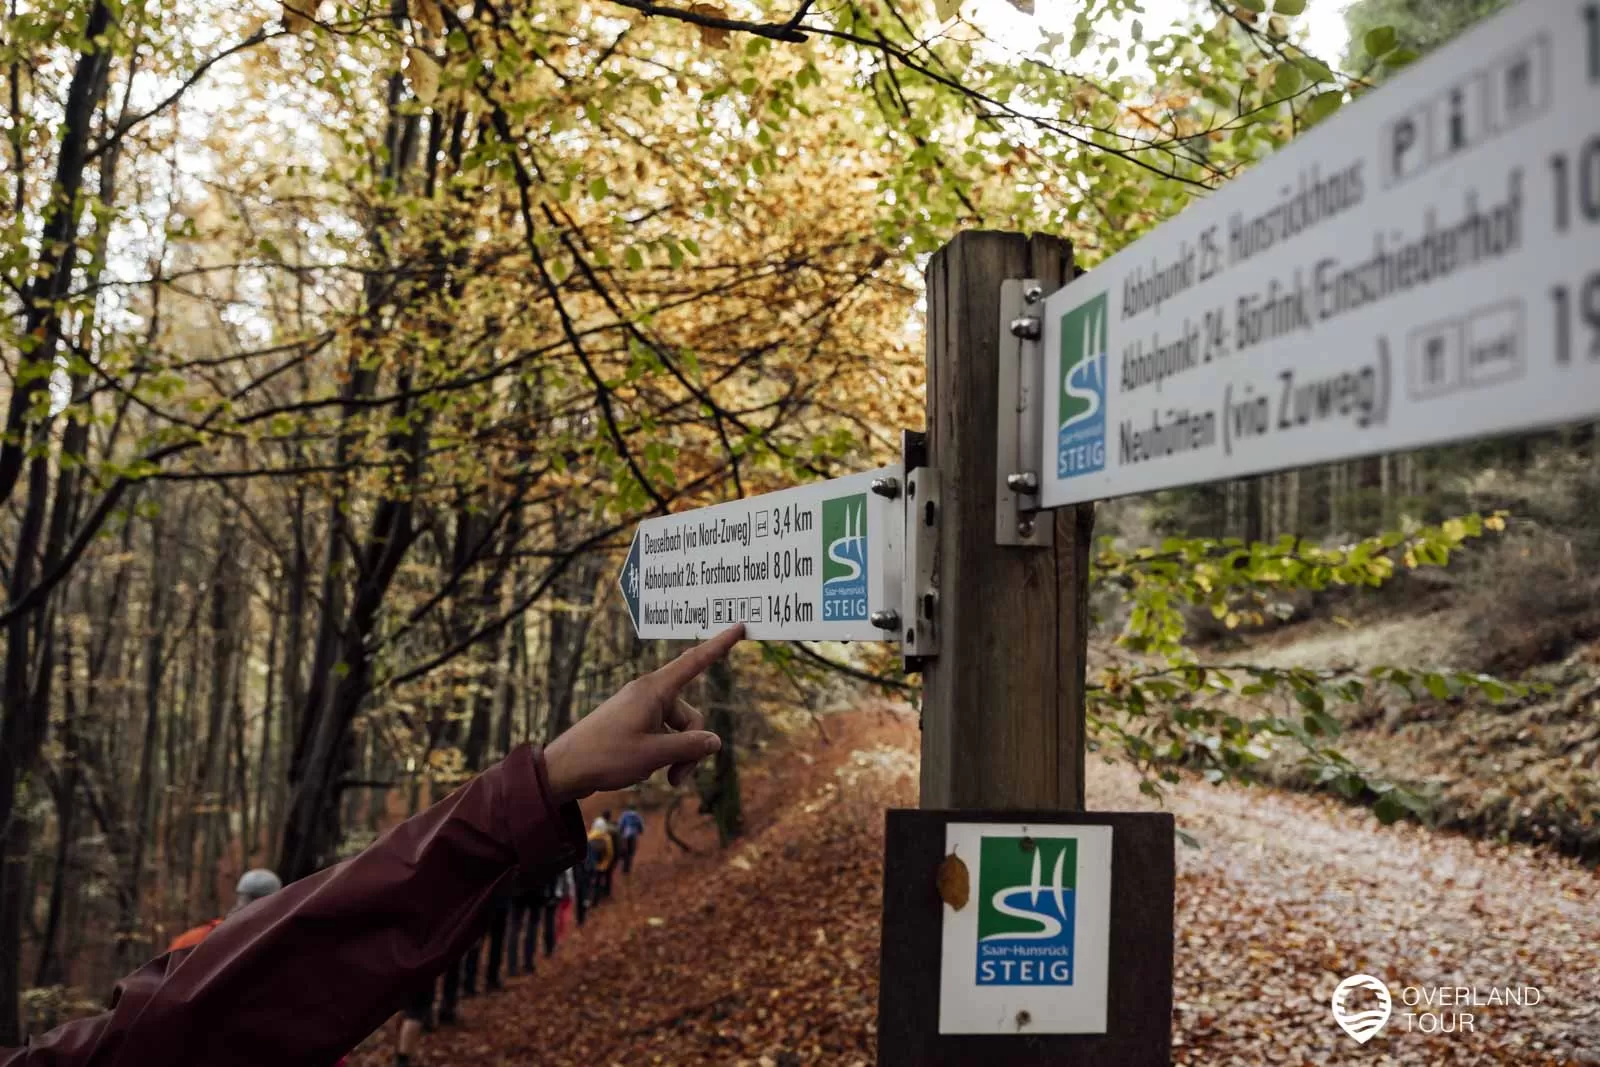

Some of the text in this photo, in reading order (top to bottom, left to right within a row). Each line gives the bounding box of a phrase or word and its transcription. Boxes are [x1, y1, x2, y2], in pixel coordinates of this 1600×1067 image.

[1120, 239, 1195, 321] Abholpunkt
[1120, 317, 1198, 393] Abholpunkt
[1119, 409, 1216, 466] Neuhütten
[1222, 382, 1269, 457] (via
[1276, 335, 1392, 430] Zuweg)
[1059, 441, 1104, 474] STEIG
[644, 503, 812, 555] Deuselbach (via Nord-Zuweg) 3,4 km
[644, 547, 812, 594] Abholpunkt 26: Forsthaus Hoxel 8,0 km
[644, 601, 669, 625] Morbach
[671, 599, 683, 630] (via
[684, 597, 709, 630] Zuweg)
[768, 594, 791, 628] 14,6
[794, 592, 813, 622] km
[824, 599, 866, 617] STEIG
[981, 944, 1069, 957] Saar-Hunsrück
[981, 960, 1069, 981] STEIG
